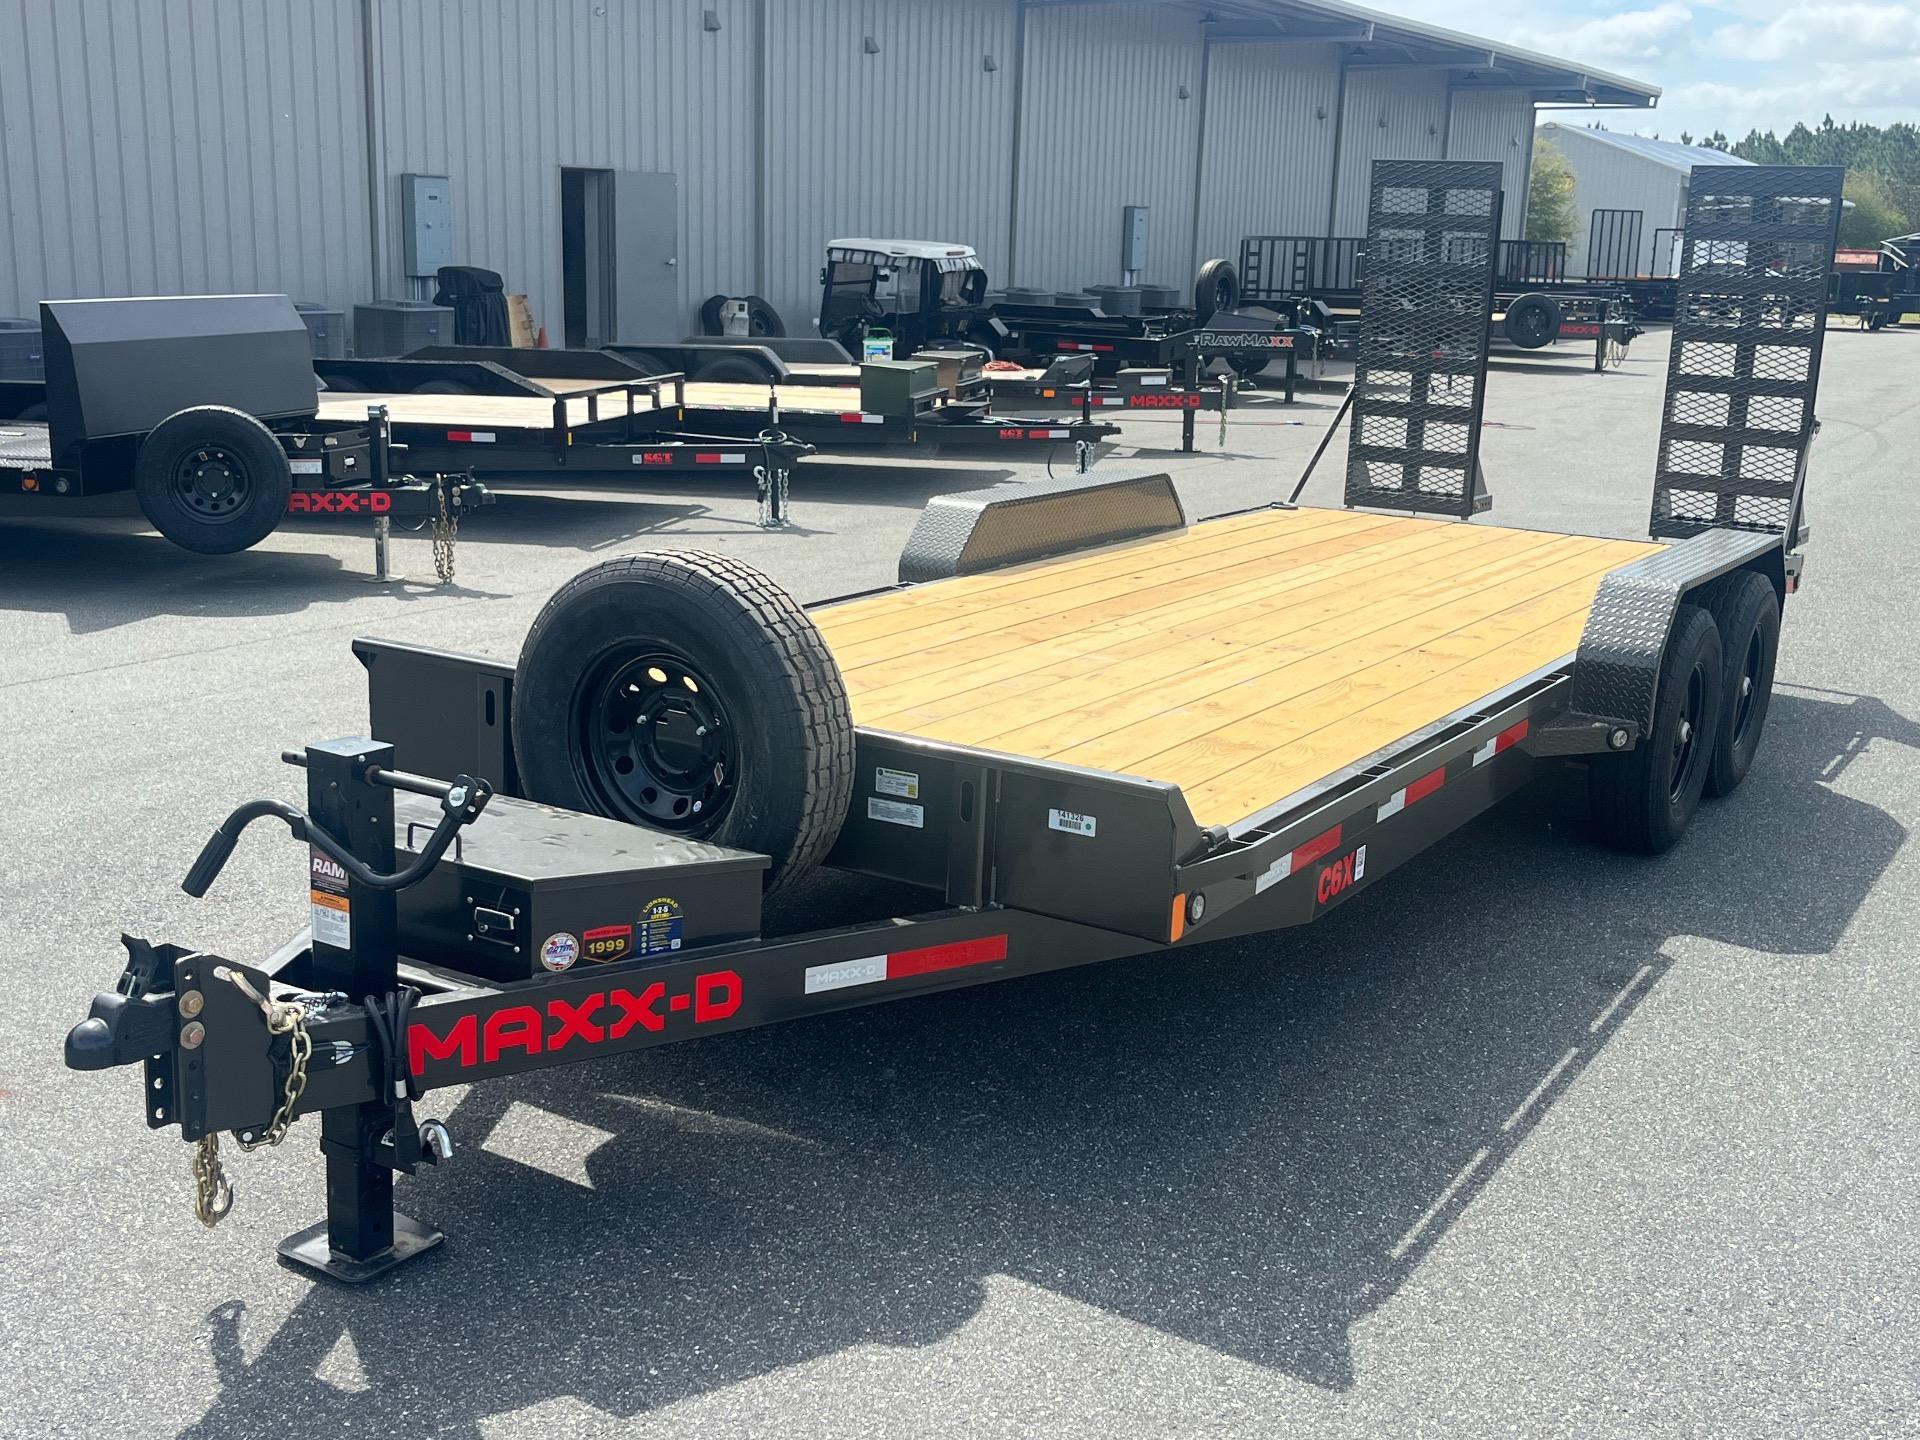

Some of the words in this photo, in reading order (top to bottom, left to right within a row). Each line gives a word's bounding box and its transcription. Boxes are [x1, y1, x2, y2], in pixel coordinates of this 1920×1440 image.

[1130, 395, 1201, 408] MAXX-D
[288, 493, 391, 512] AXX-D
[1057, 810, 1084, 822] 141326
[312, 857, 345, 879] RAM
[1317, 849, 1356, 905] C6X
[642, 897, 679, 913] LIONSHEAD
[588, 938, 625, 954] 1999
[816, 965, 876, 985] MAXX-D
[408, 970, 743, 1076] MAXX-D
